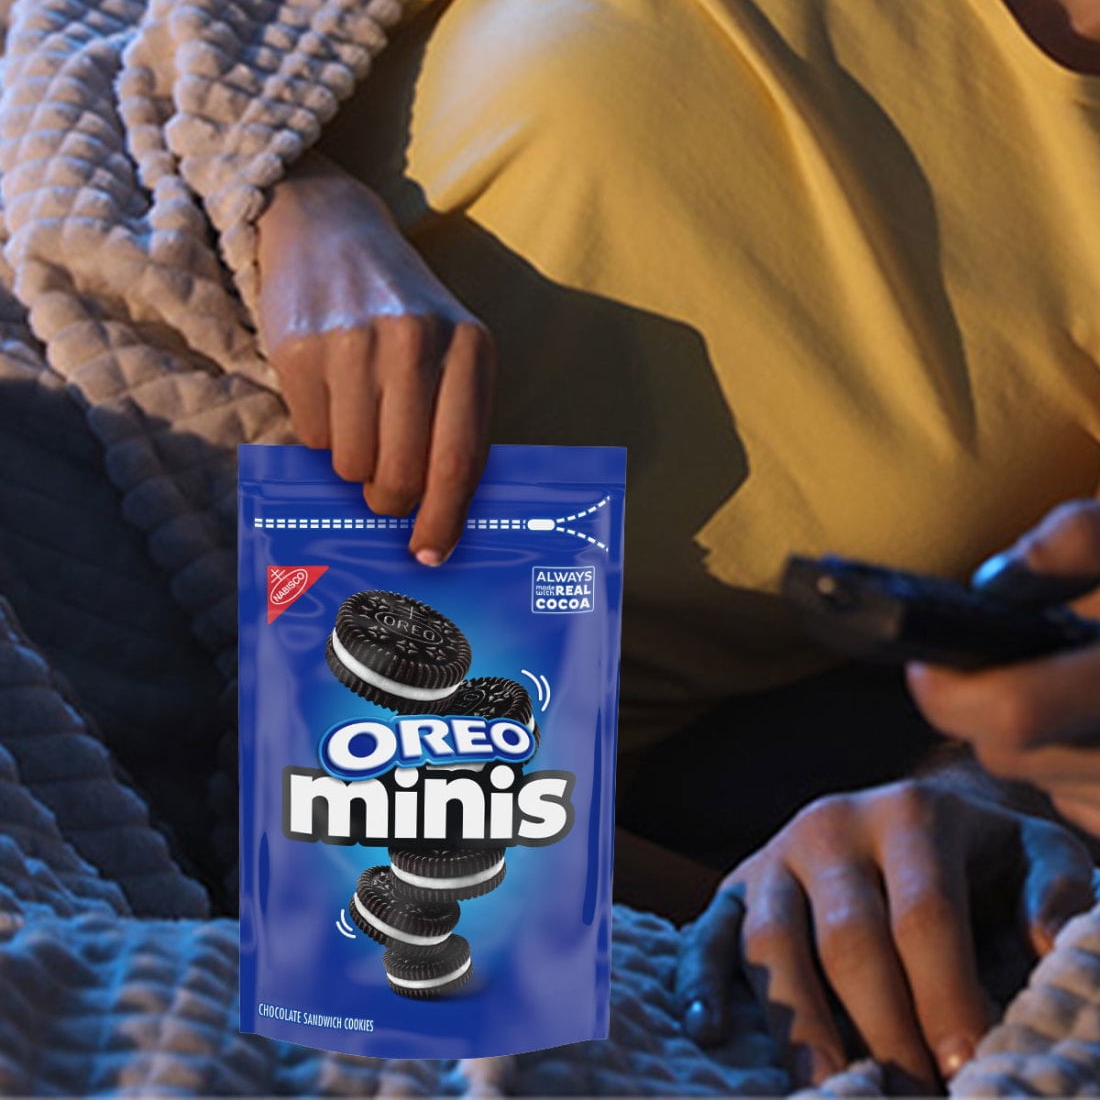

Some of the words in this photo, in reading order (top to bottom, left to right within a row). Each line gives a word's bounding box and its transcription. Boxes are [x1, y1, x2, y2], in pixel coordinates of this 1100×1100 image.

[273, 572, 305, 602] NABISCO
[536, 571, 592, 582] ALWAYS
[536, 598, 590, 610] COCOA
[556, 585, 591, 596] REAL
[383, 615, 435, 641] OREO
[327, 717, 531, 771] OREO
[289, 764, 568, 840] minis
[258, 1003, 302, 1024] CHOCOLATE
[303, 1012, 342, 1029] SANDWICH
[344, 1017, 374, 1032] COOKIES
